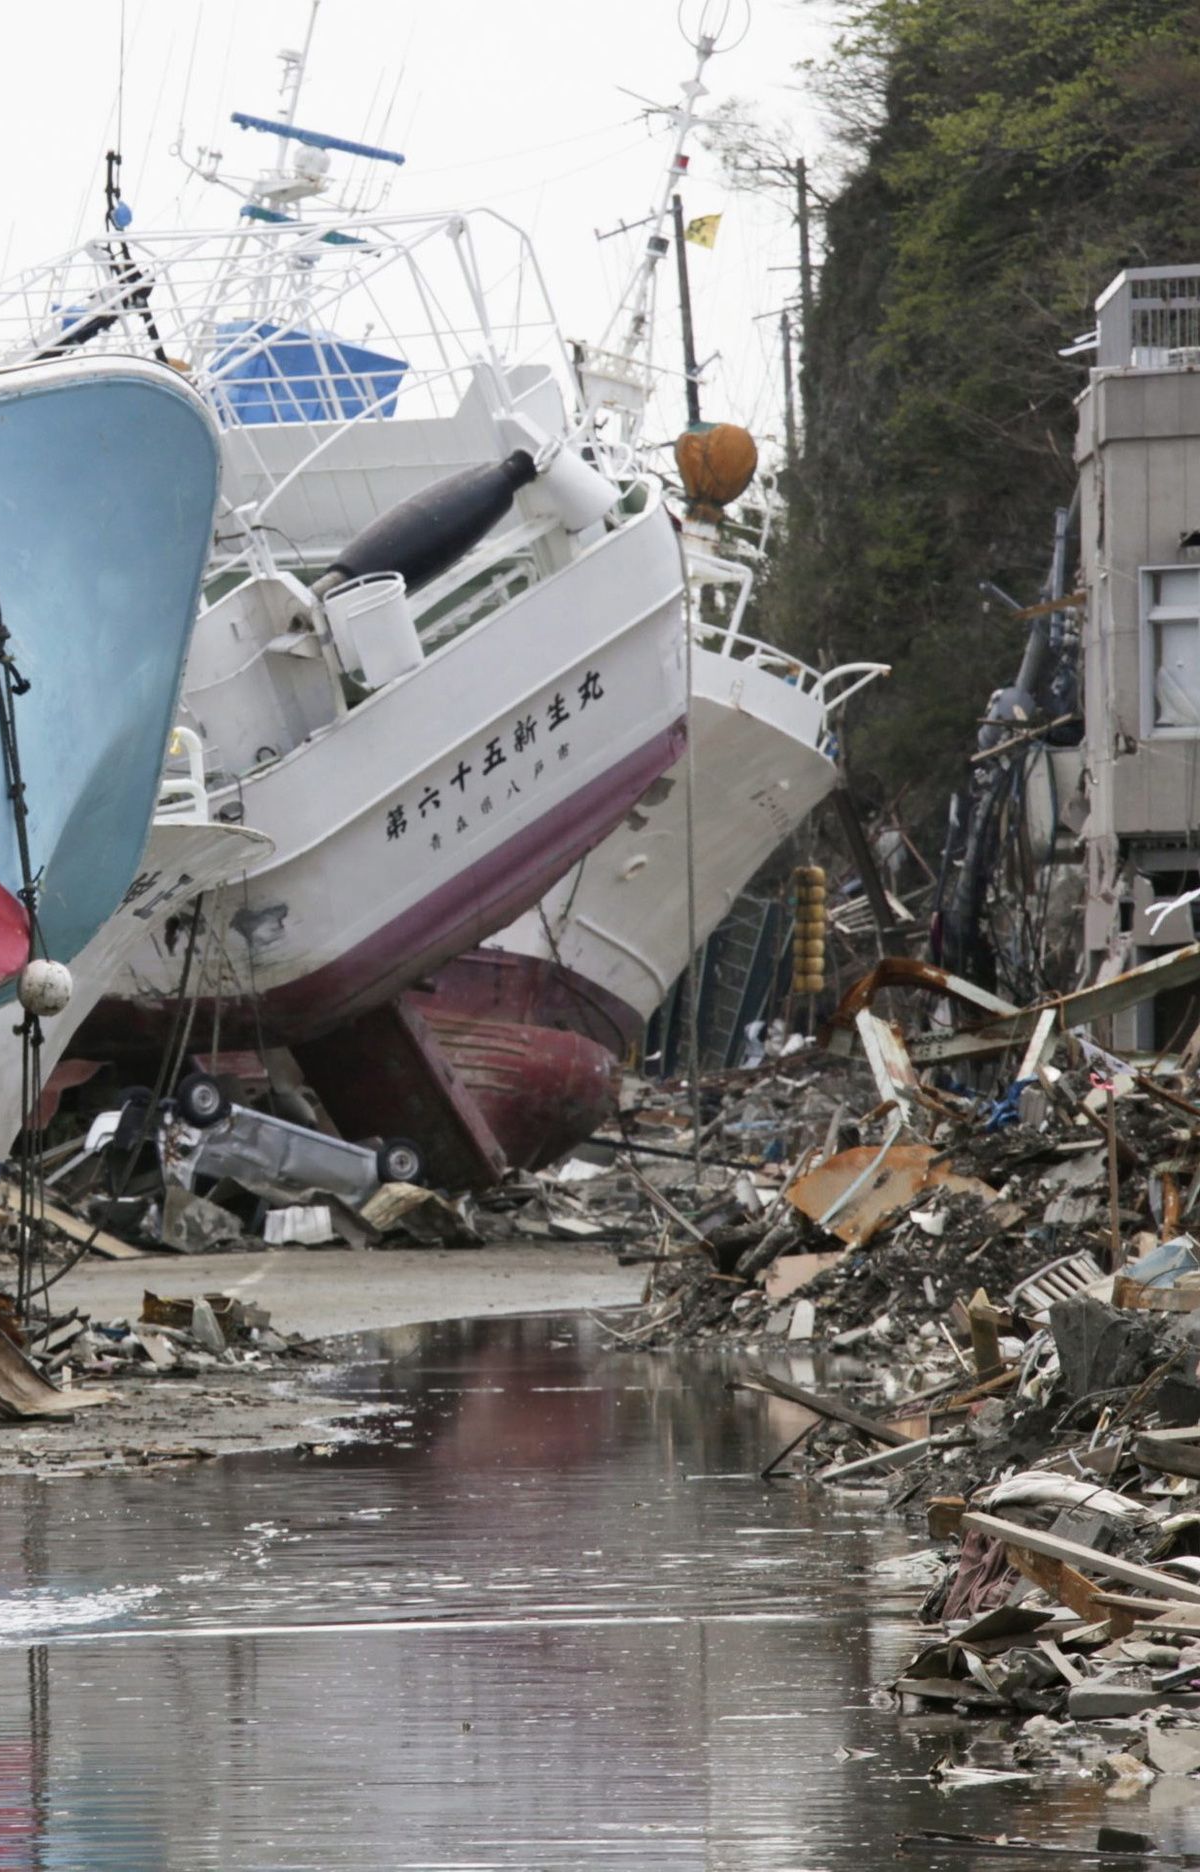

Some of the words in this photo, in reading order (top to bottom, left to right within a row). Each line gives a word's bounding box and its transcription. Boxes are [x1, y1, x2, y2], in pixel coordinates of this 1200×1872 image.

[386, 671, 605, 841] 第六十五新生丸
